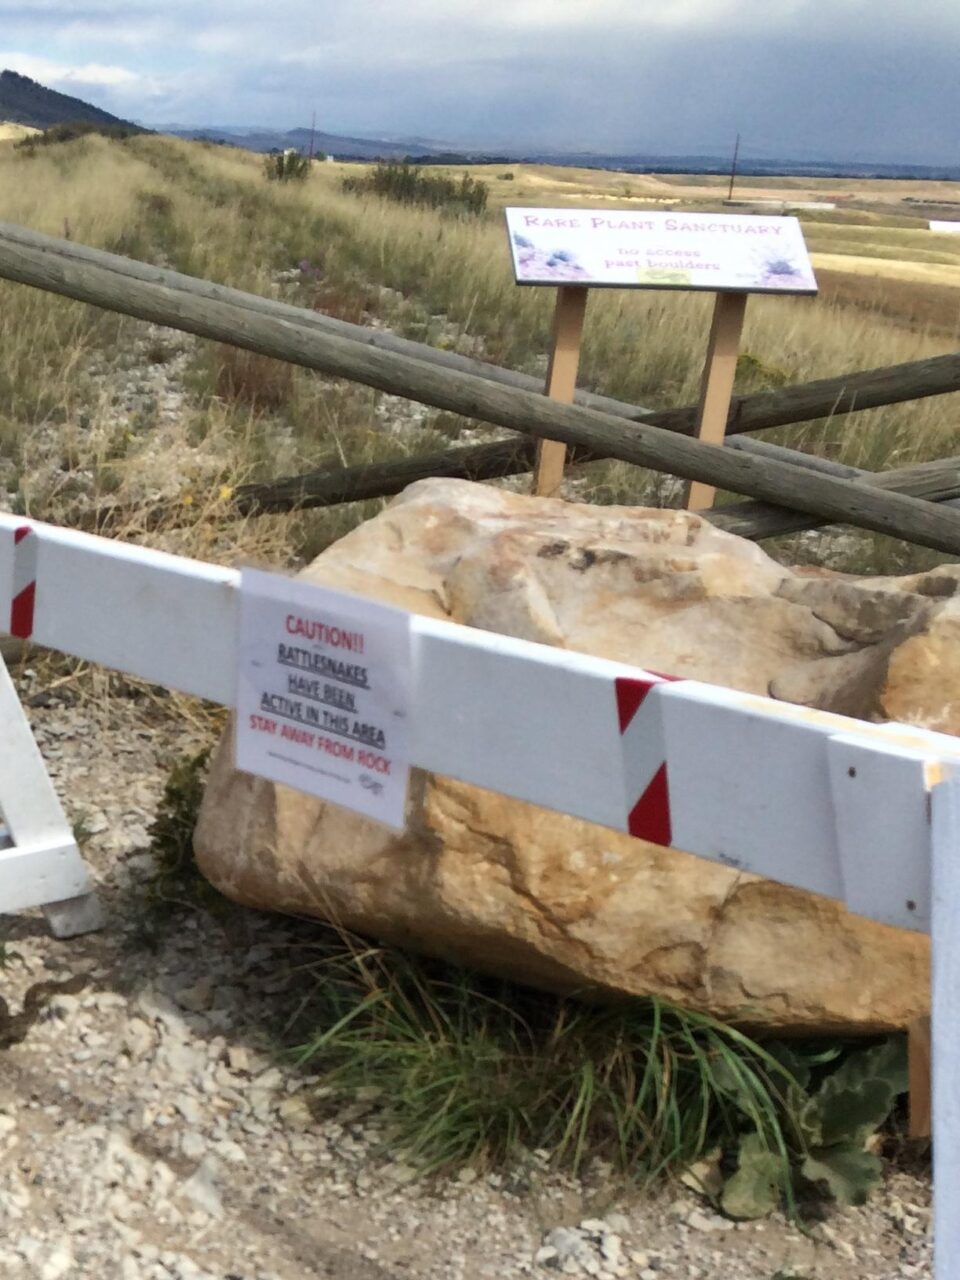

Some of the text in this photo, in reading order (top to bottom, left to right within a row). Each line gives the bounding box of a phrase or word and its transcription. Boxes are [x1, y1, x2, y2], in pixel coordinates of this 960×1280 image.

[591, 217, 655, 231] PLANT
[664, 219, 783, 235] SANCTUARY
[604, 258, 720, 270] past boulders
[618, 247, 701, 257] no access
[286, 615, 364, 653] CAUTION!!
[278, 643, 369, 686] RATTLESNAKES
[288, 674, 355, 710] HAVE BEEN
[261, 692, 385, 744] ACTIVE IN THIS AREA
[250, 715, 277, 734] STAY
[281, 724, 314, 746] AWAY
[317, 736, 354, 762] FROM
[357, 749, 390, 774] ROCK
